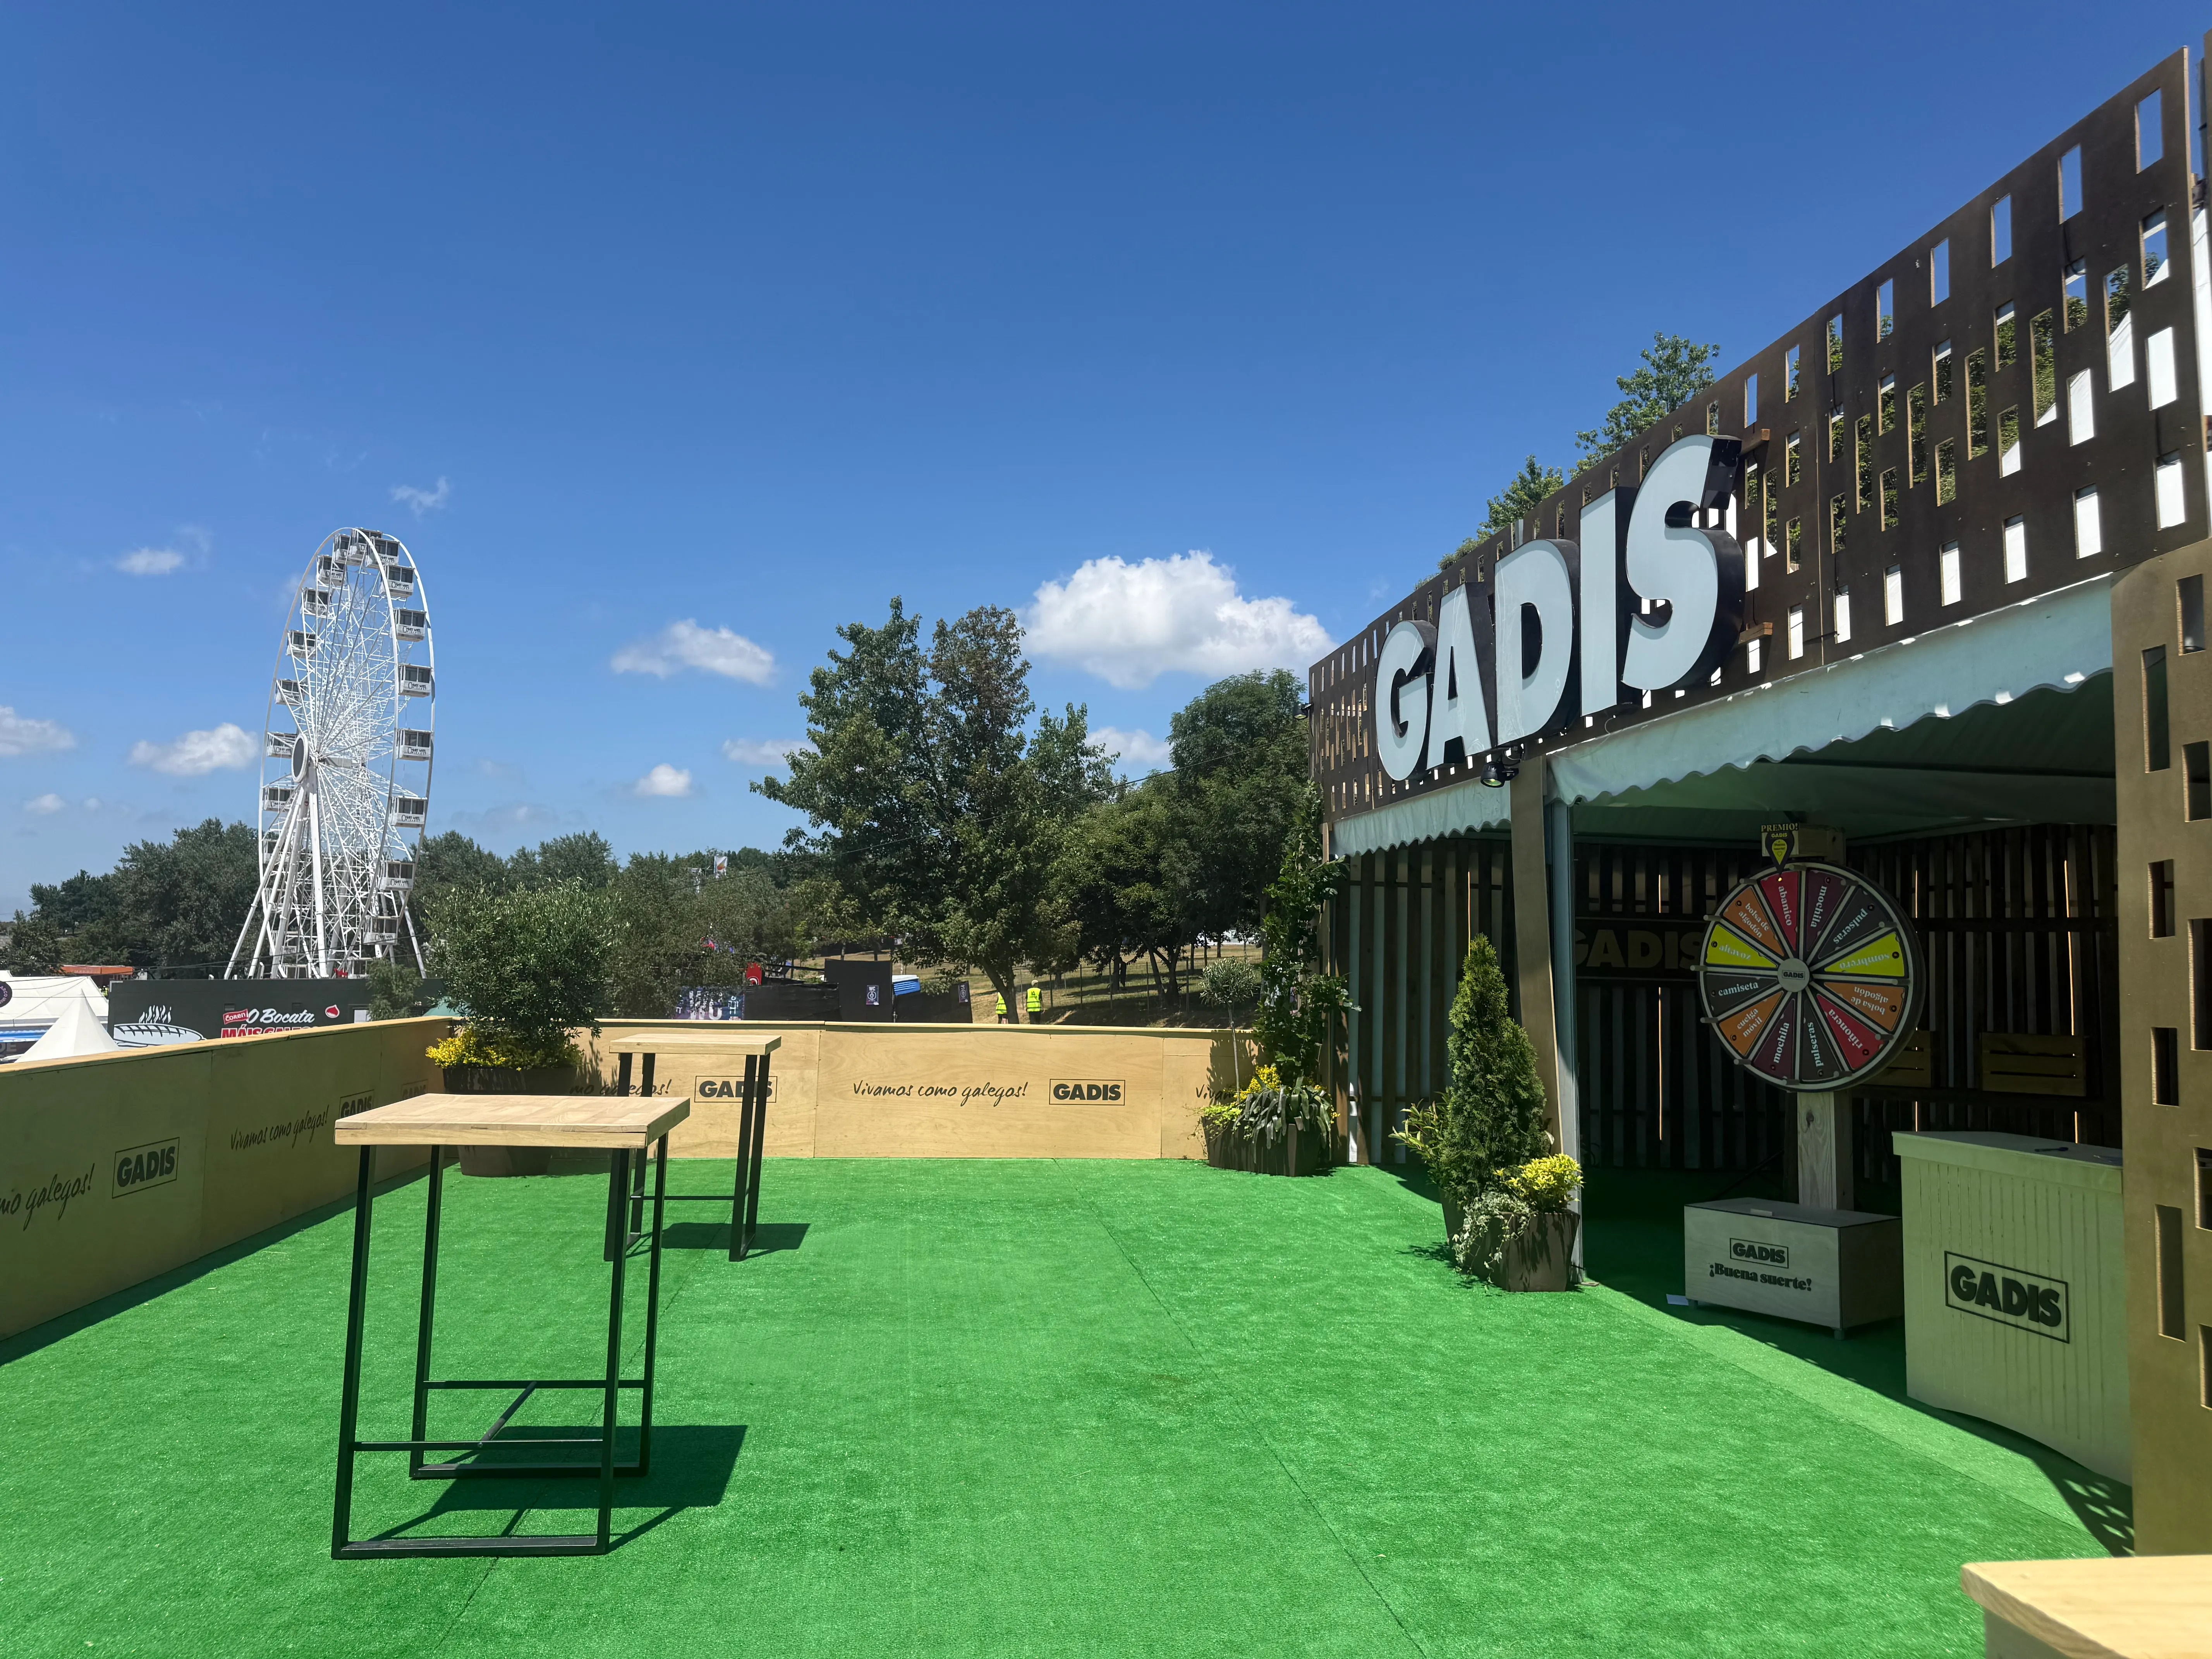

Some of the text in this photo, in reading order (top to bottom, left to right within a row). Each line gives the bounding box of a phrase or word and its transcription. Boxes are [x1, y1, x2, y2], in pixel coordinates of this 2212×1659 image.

[1376, 434, 1744, 781] GADIS
[1761, 823, 1798, 831] PREMIO!
[1745, 903, 1769, 931] bolsa de
[1778, 886, 1792, 926] abanico
[1810, 885, 1827, 927] mochila
[1738, 911, 1762, 938] algodón
[1833, 908, 1868, 944] pulseras
[1719, 945, 1751, 960] altavoz
[1839, 953, 1890, 969] sombrero
[1718, 982, 1759, 996] camiseta
[1854, 986, 1888, 1003] algodón
[246, 1008, 315, 1024] O Bocata
[1737, 1008, 1759, 1029] cuelga
[1851, 996, 1885, 1015] bolsa de
[1743, 1017, 1762, 1037] móvil
[1829, 1009, 1863, 1049] riñonera
[1774, 1022, 1789, 1063] mochila
[1807, 1022, 1824, 1067] pulseras
[853, 1080, 1028, 1106] Vivamos como galegos!
[1053, 1084, 1121, 1101] GADIS
[231, 1104, 330, 1151] Vivamos como galegos!
[117, 1146, 175, 1187] GADIS
[23, 1163, 95, 1231] galegos!
[1733, 1243, 1785, 1263] GADIS
[1709, 1263, 1812, 1291] ¡Buena suerte!
[1951, 1265, 2061, 1327] GADIS
